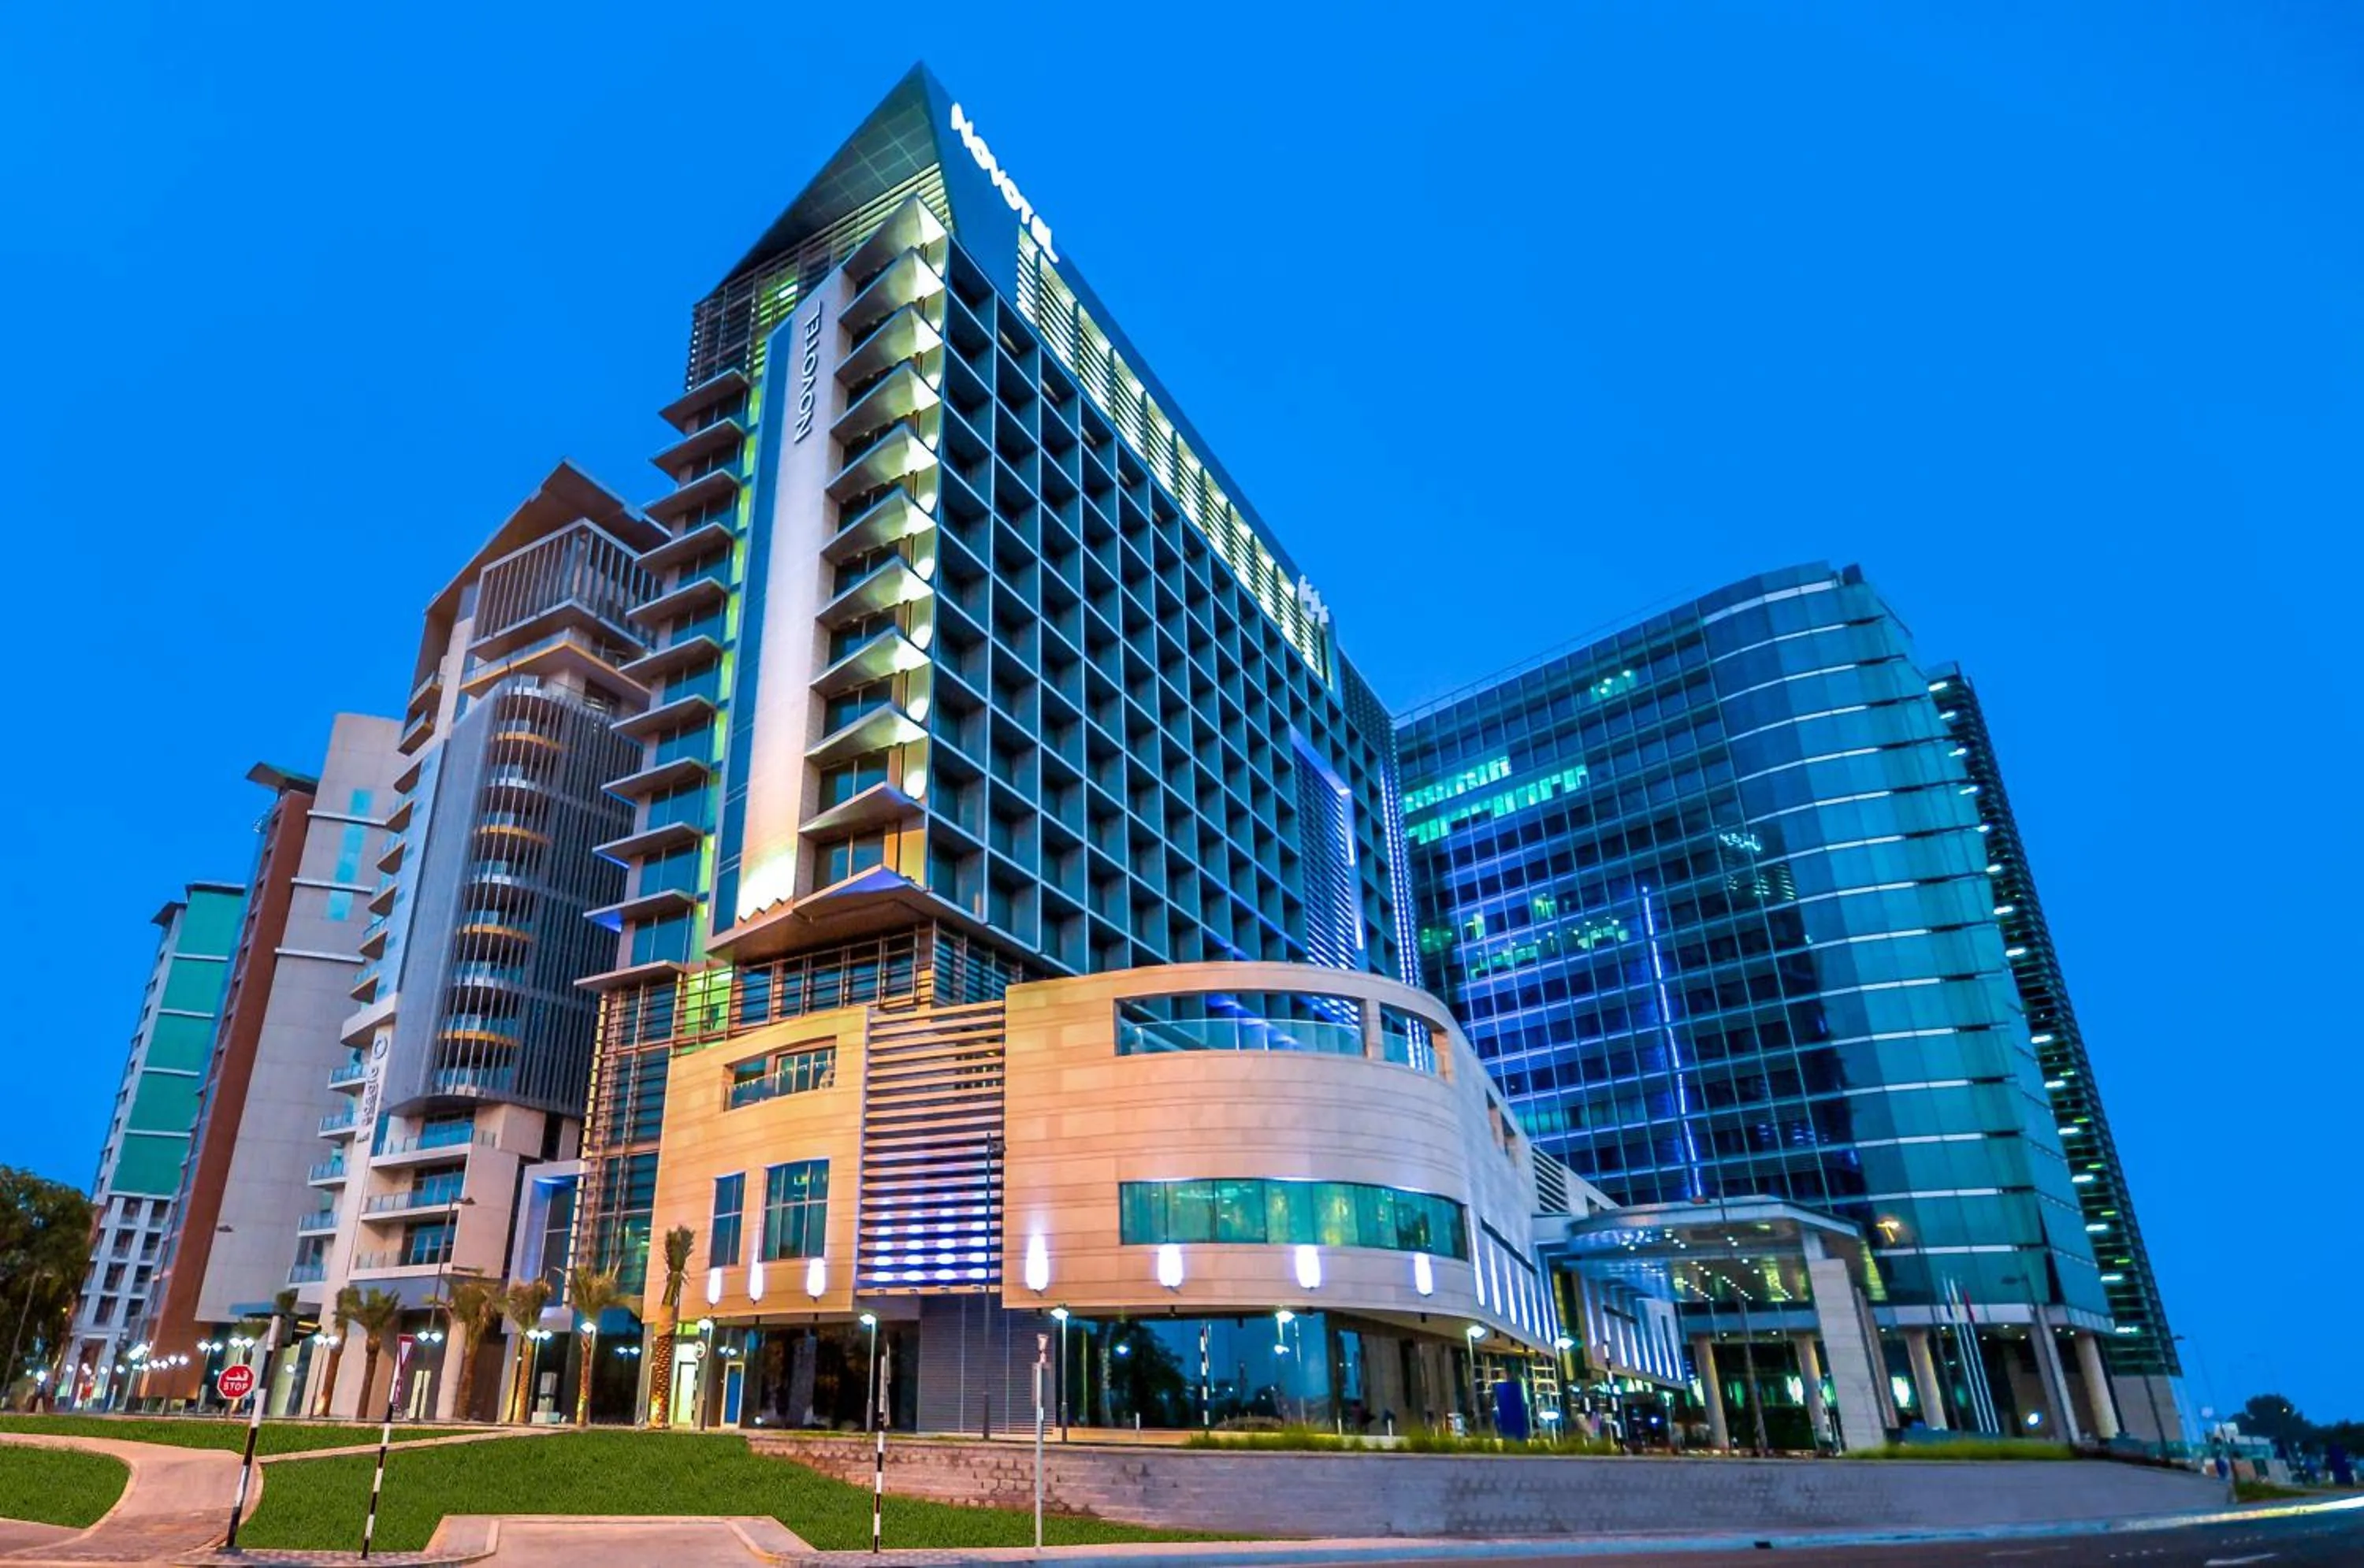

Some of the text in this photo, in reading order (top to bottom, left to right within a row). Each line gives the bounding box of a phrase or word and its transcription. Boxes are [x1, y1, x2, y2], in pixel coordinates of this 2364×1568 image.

[951, 102, 1060, 263] NOVOTEL
[794, 300, 822, 444] NOVOTEL
[223, 1381, 248, 1391] STOP
